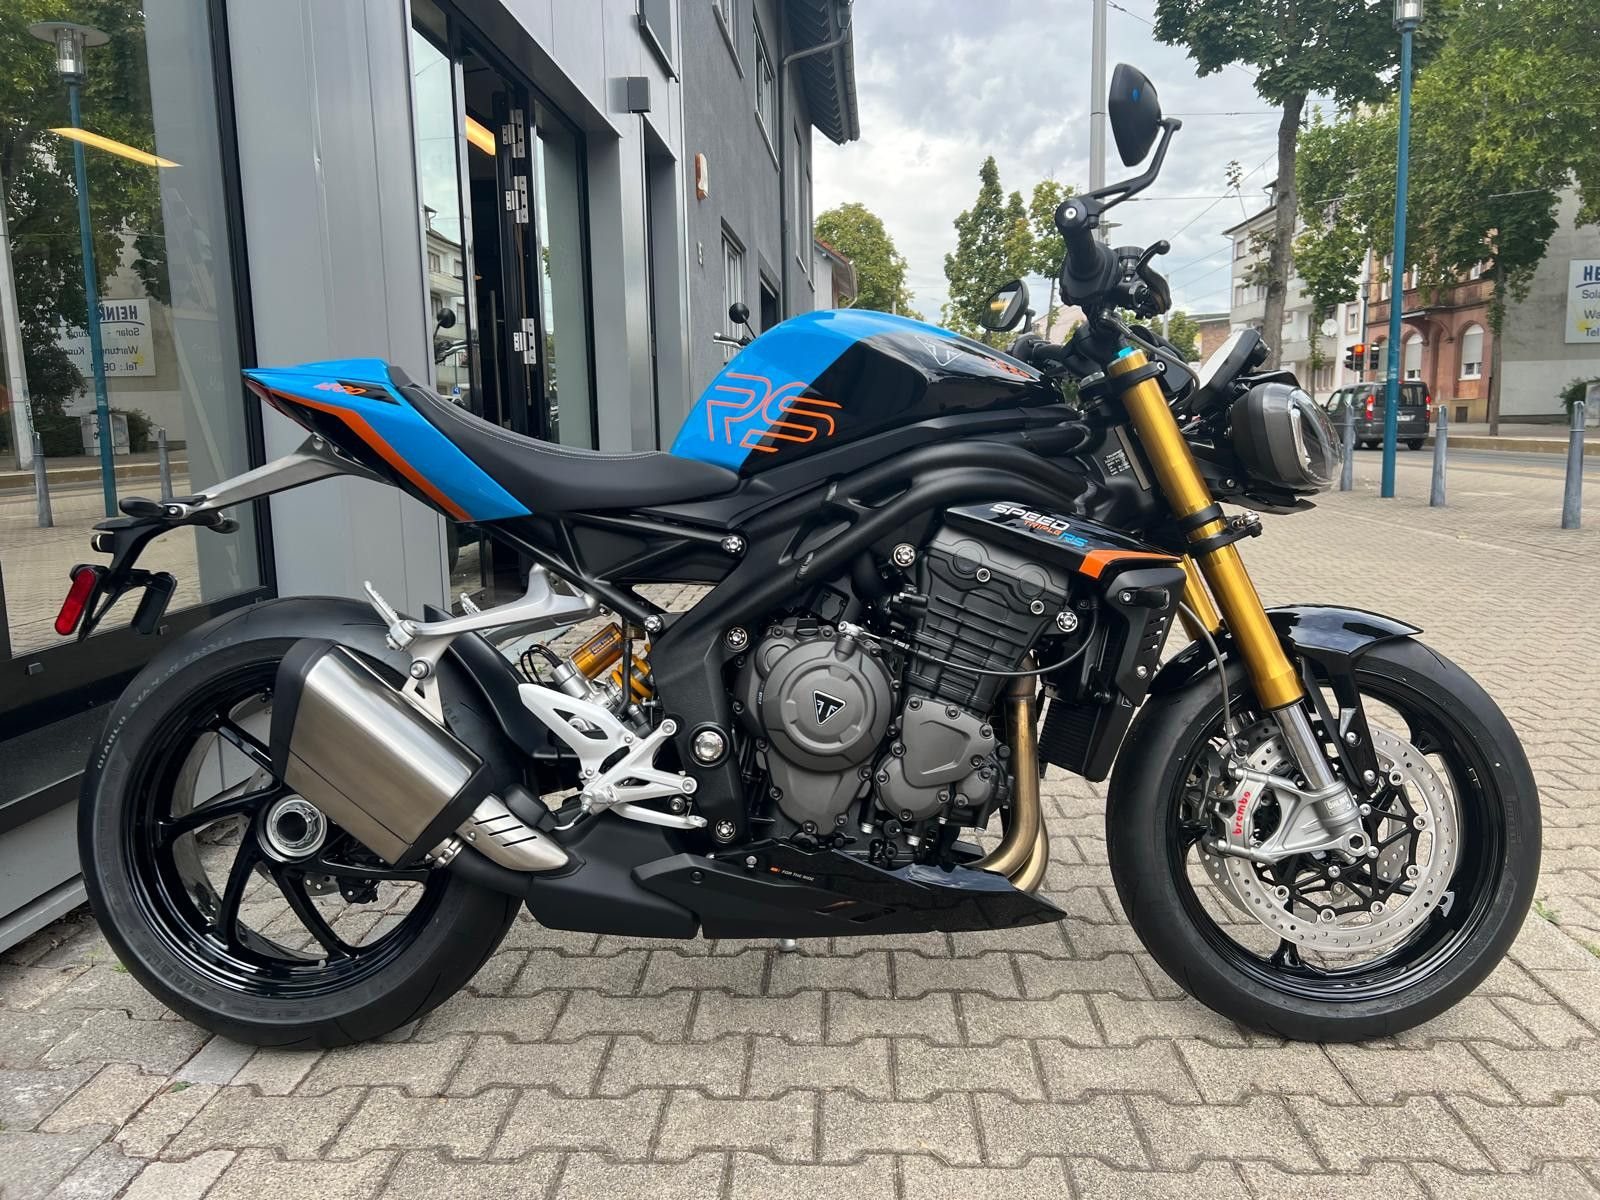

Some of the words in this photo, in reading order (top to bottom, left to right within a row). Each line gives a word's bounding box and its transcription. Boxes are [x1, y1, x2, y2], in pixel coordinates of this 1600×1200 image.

[706, 372, 842, 453] RS
[990, 503, 1070, 531] SPEED
[1058, 532, 1089, 547] RS
[1233, 791, 1250, 836] brembo
